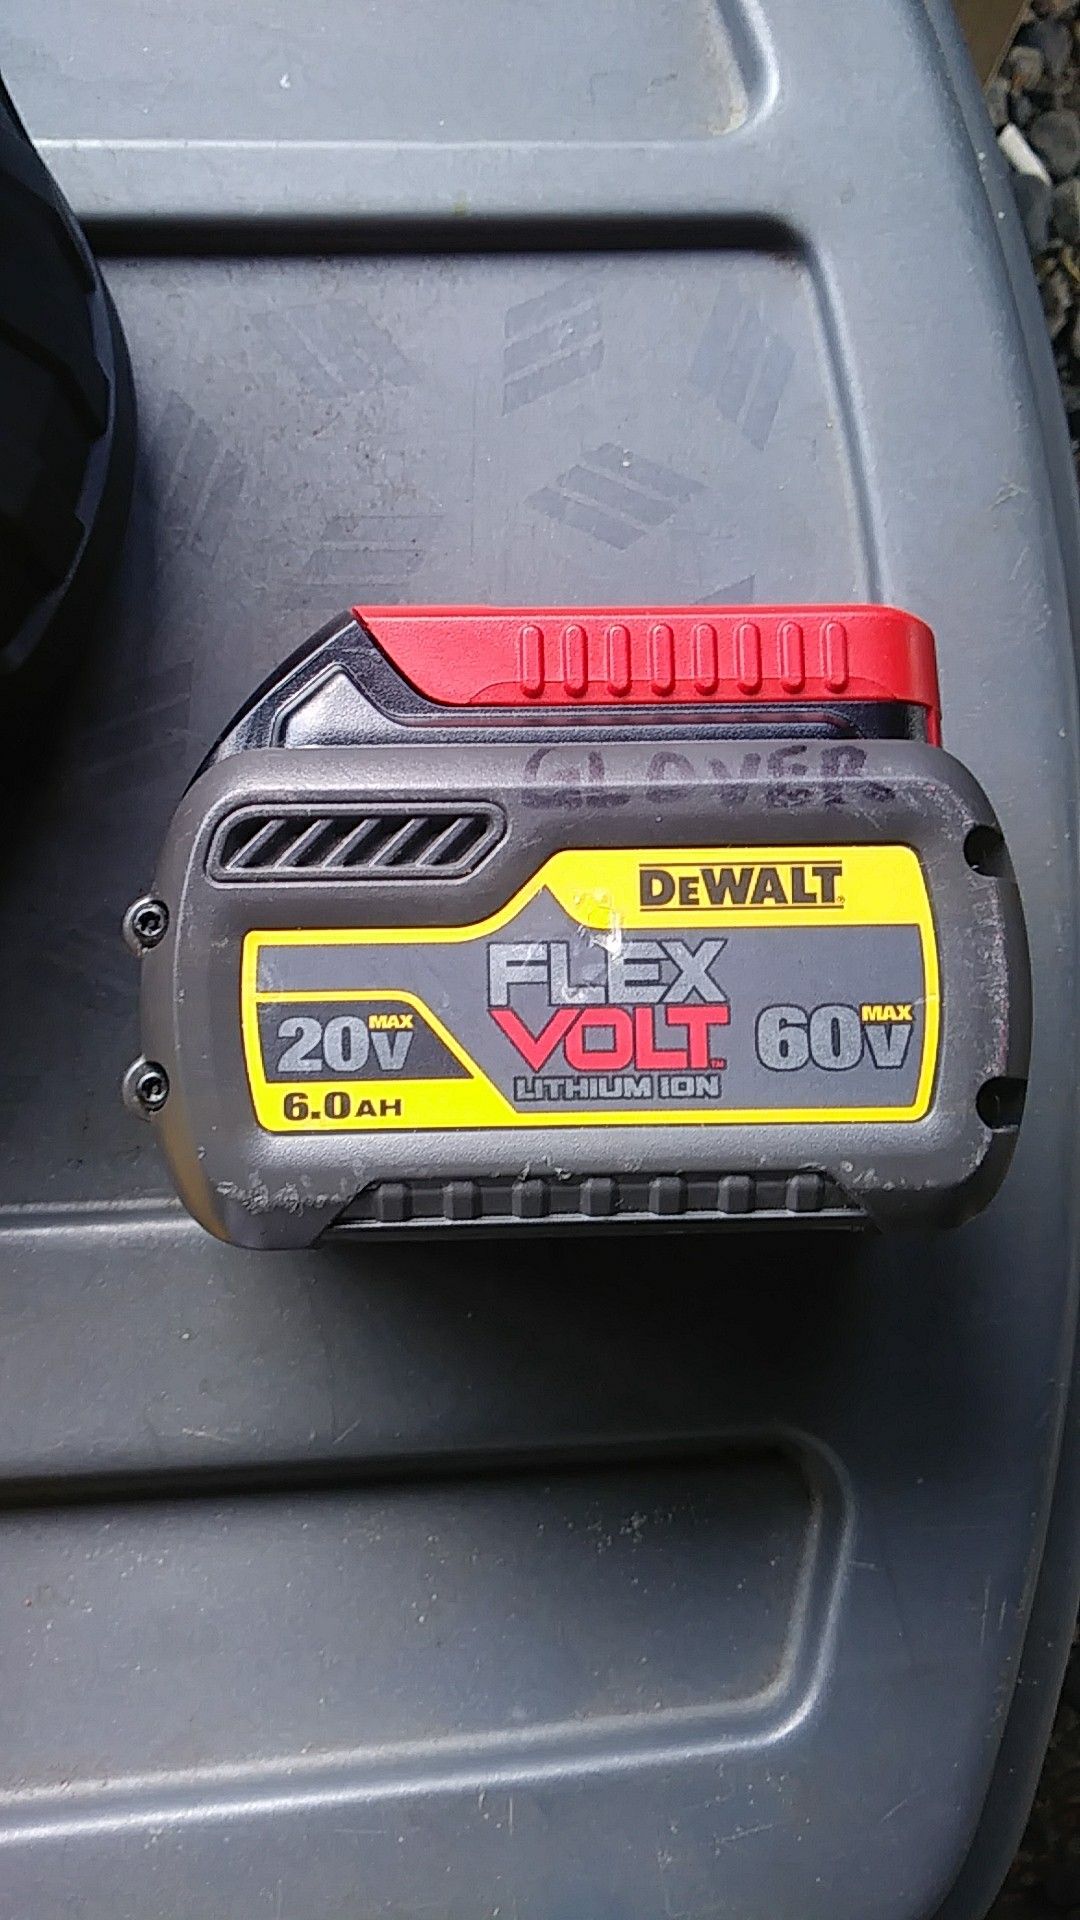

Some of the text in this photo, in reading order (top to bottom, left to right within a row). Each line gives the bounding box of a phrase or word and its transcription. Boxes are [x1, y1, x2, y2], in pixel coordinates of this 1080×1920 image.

[487, 938, 728, 1008] FLEX
[368, 1013, 415, 1030] MAX
[861, 1004, 914, 1022] MAX
[514, 1073, 722, 1102] LITHIUM ION
